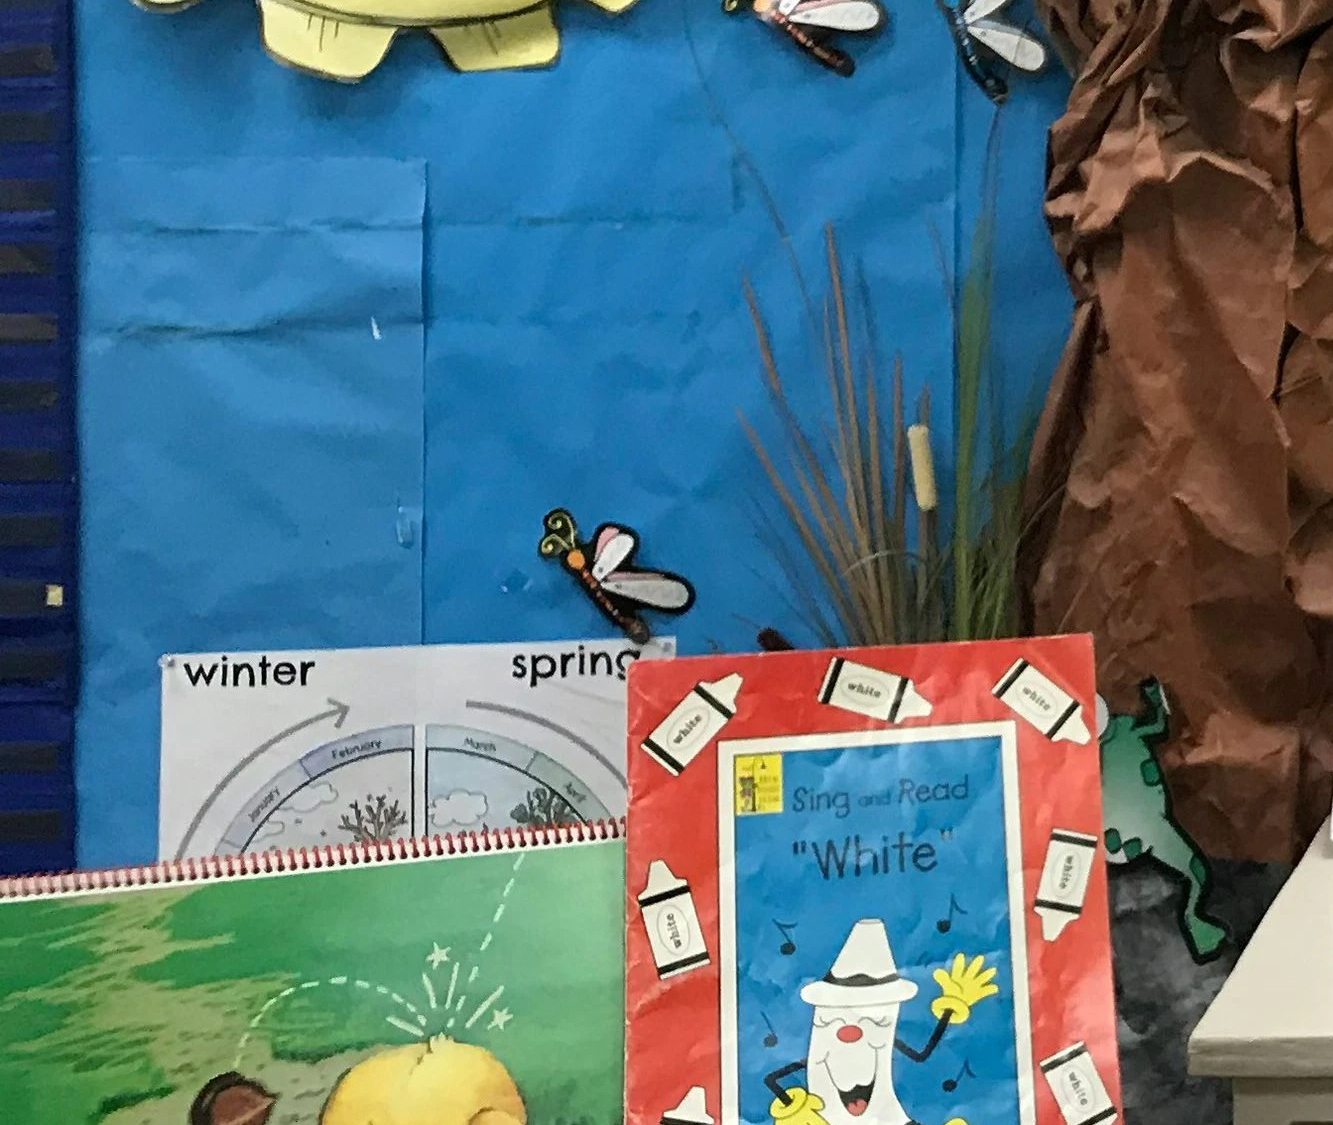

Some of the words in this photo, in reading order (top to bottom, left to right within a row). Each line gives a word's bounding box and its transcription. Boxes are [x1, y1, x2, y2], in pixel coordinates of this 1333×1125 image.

[183, 655, 315, 688] winter
[512, 646, 642, 686] spring
[847, 681, 881, 699] white
[1022, 687, 1051, 712] white
[672, 714, 702, 744] white
[332, 739, 382, 759] February
[792, 786, 850, 817] Sing
[858, 790, 891, 808] and
[899, 775, 969, 804] Read
[792, 827, 955, 880] "White"
[1058, 855, 1075, 890] white
[666, 912, 682, 949] white
[1068, 1071, 1088, 1106] white
